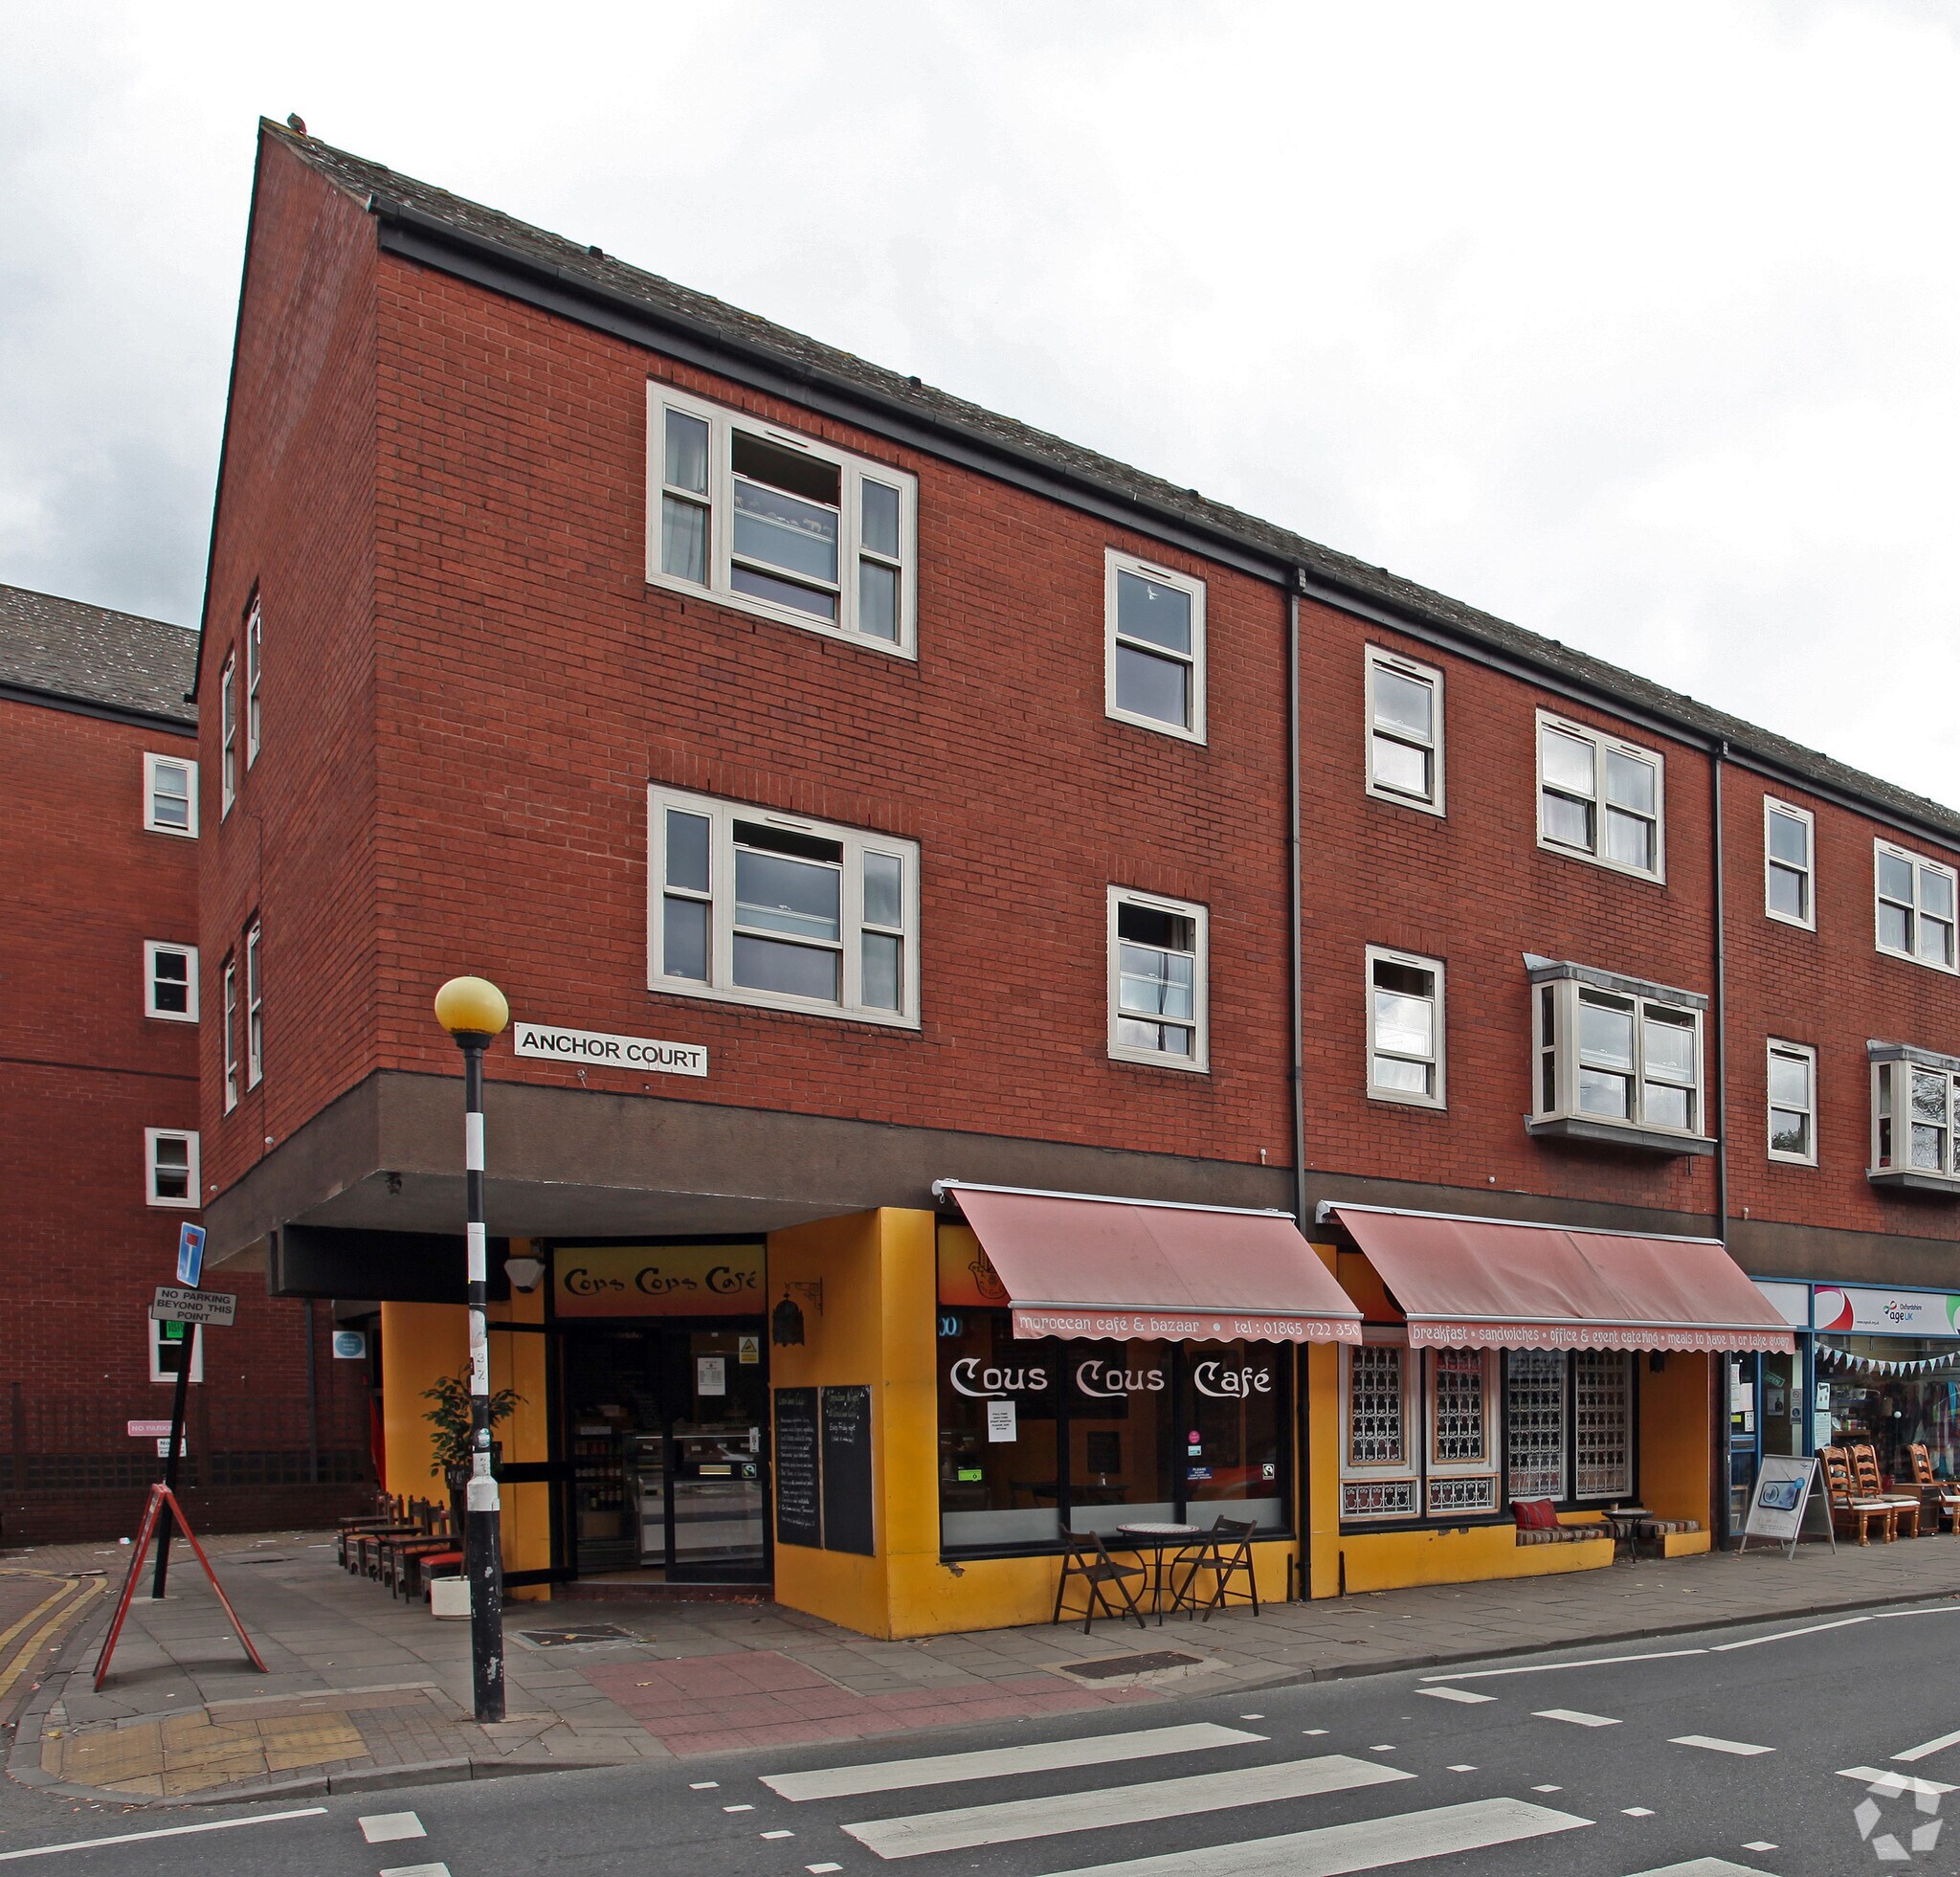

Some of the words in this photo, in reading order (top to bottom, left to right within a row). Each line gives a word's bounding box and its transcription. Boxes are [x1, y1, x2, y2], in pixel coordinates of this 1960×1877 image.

[522, 1031, 621, 1059] ANCHOR
[627, 1044, 701, 1068] COURT
[564, 1267, 625, 1296] Cous
[635, 1266, 698, 1295] Cous
[705, 1265, 758, 1295] Café
[157, 1299, 203, 1311] BEYOND
[208, 1304, 233, 1314] THIS
[161, 1289, 179, 1299] NO
[183, 1291, 231, 1305] PARKING
[176, 1310, 211, 1322] POINT
[1019, 1316, 1092, 1331] moroccan
[1096, 1315, 1128, 1334] café
[1133, 1316, 1146, 1331] &
[1149, 1317, 1200, 1333] bazaar
[1263, 1321, 1303, 1335] 01865
[1306, 1323, 1332, 1336] 722
[1335, 1323, 1360, 1336] 350
[1413, 1324, 1468, 1343] breakfast
[1479, 1326, 1540, 1343] sandwiches
[1550, 1328, 1578, 1345] office
[1580, 1328, 1590, 1343] &
[1592, 1330, 1618, 1345] event
[1620, 1330, 1659, 1347] catering
[1668, 1331, 1693, 1346] meals
[1695, 1331, 1704, 1346] to
[1706, 1331, 1727, 1348] have
[1728, 1331, 1737, 1348] in
[1738, 1334, 1748, 1346] or
[1748, 1333, 1768, 1348] take
[1769, 1335, 1790, 1350] away
[949, 1357, 1049, 1397] Cous
[1075, 1359, 1166, 1397] Cous
[1193, 1360, 1272, 1398] Café
